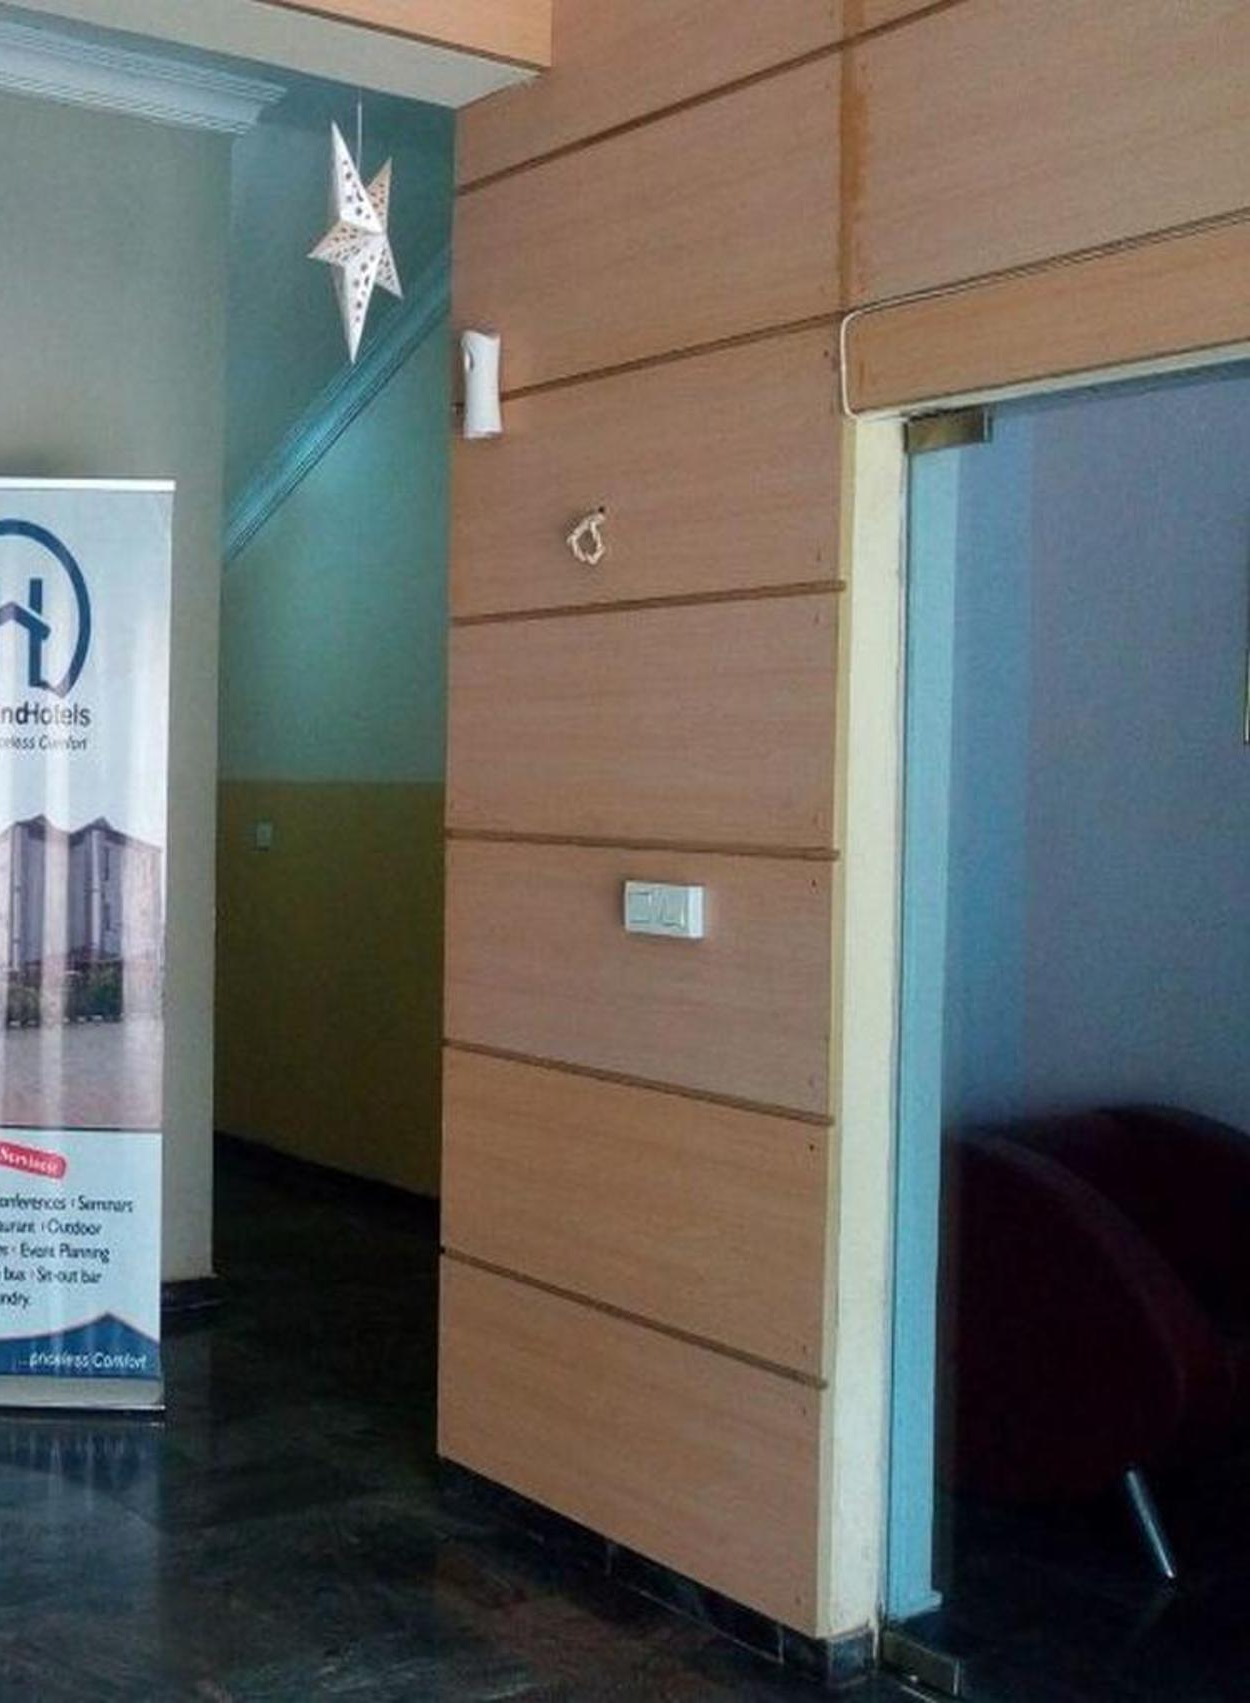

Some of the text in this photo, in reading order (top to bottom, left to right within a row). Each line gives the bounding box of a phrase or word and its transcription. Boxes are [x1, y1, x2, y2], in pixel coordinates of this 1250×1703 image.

[78, 1195, 133, 1213] Seminars
[48, 1218, 102, 1235] Outdoor
[20, 1242, 55, 1258] Event
[59, 1243, 110, 1264] Planning
[4, 1265, 27, 1281] bus
[81, 1269, 103, 1284] bar
